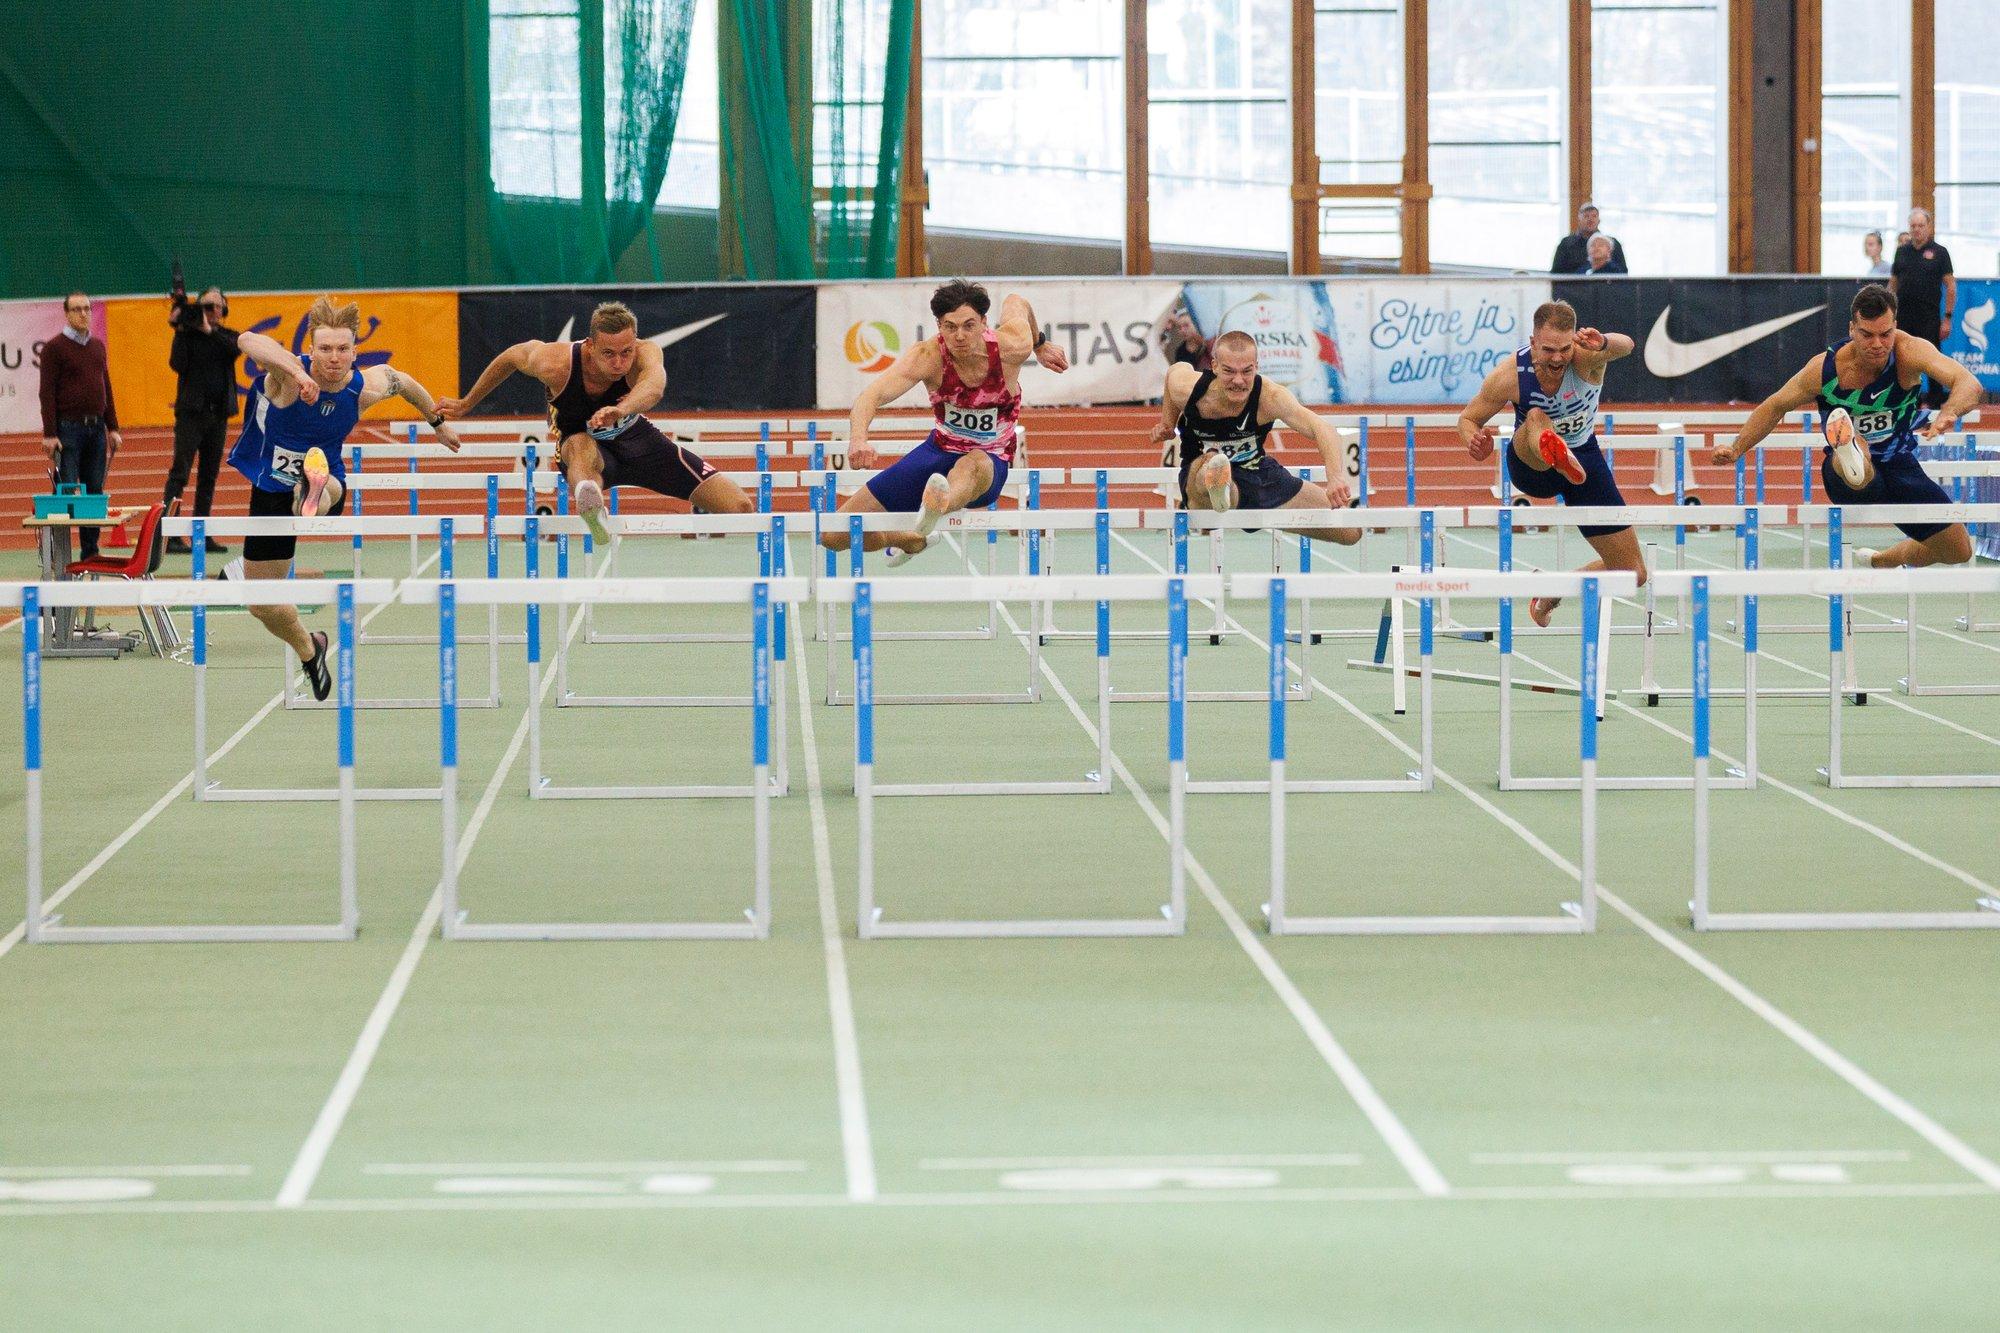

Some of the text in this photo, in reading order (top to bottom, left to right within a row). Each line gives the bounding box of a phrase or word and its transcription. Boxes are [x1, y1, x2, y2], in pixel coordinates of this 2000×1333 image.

[1457, 299, 1515, 345] ja
[1253, 332, 1307, 348] RSKA
[949, 410, 993, 431] 208
[1163, 444, 1175, 468] 4
[1207, 442, 1251, 459] 84
[1347, 444, 1360, 477] 3
[558, 538, 568, 555] Sport
[759, 536, 770, 553] Sport
[1436, 581, 1470, 593] Sport
